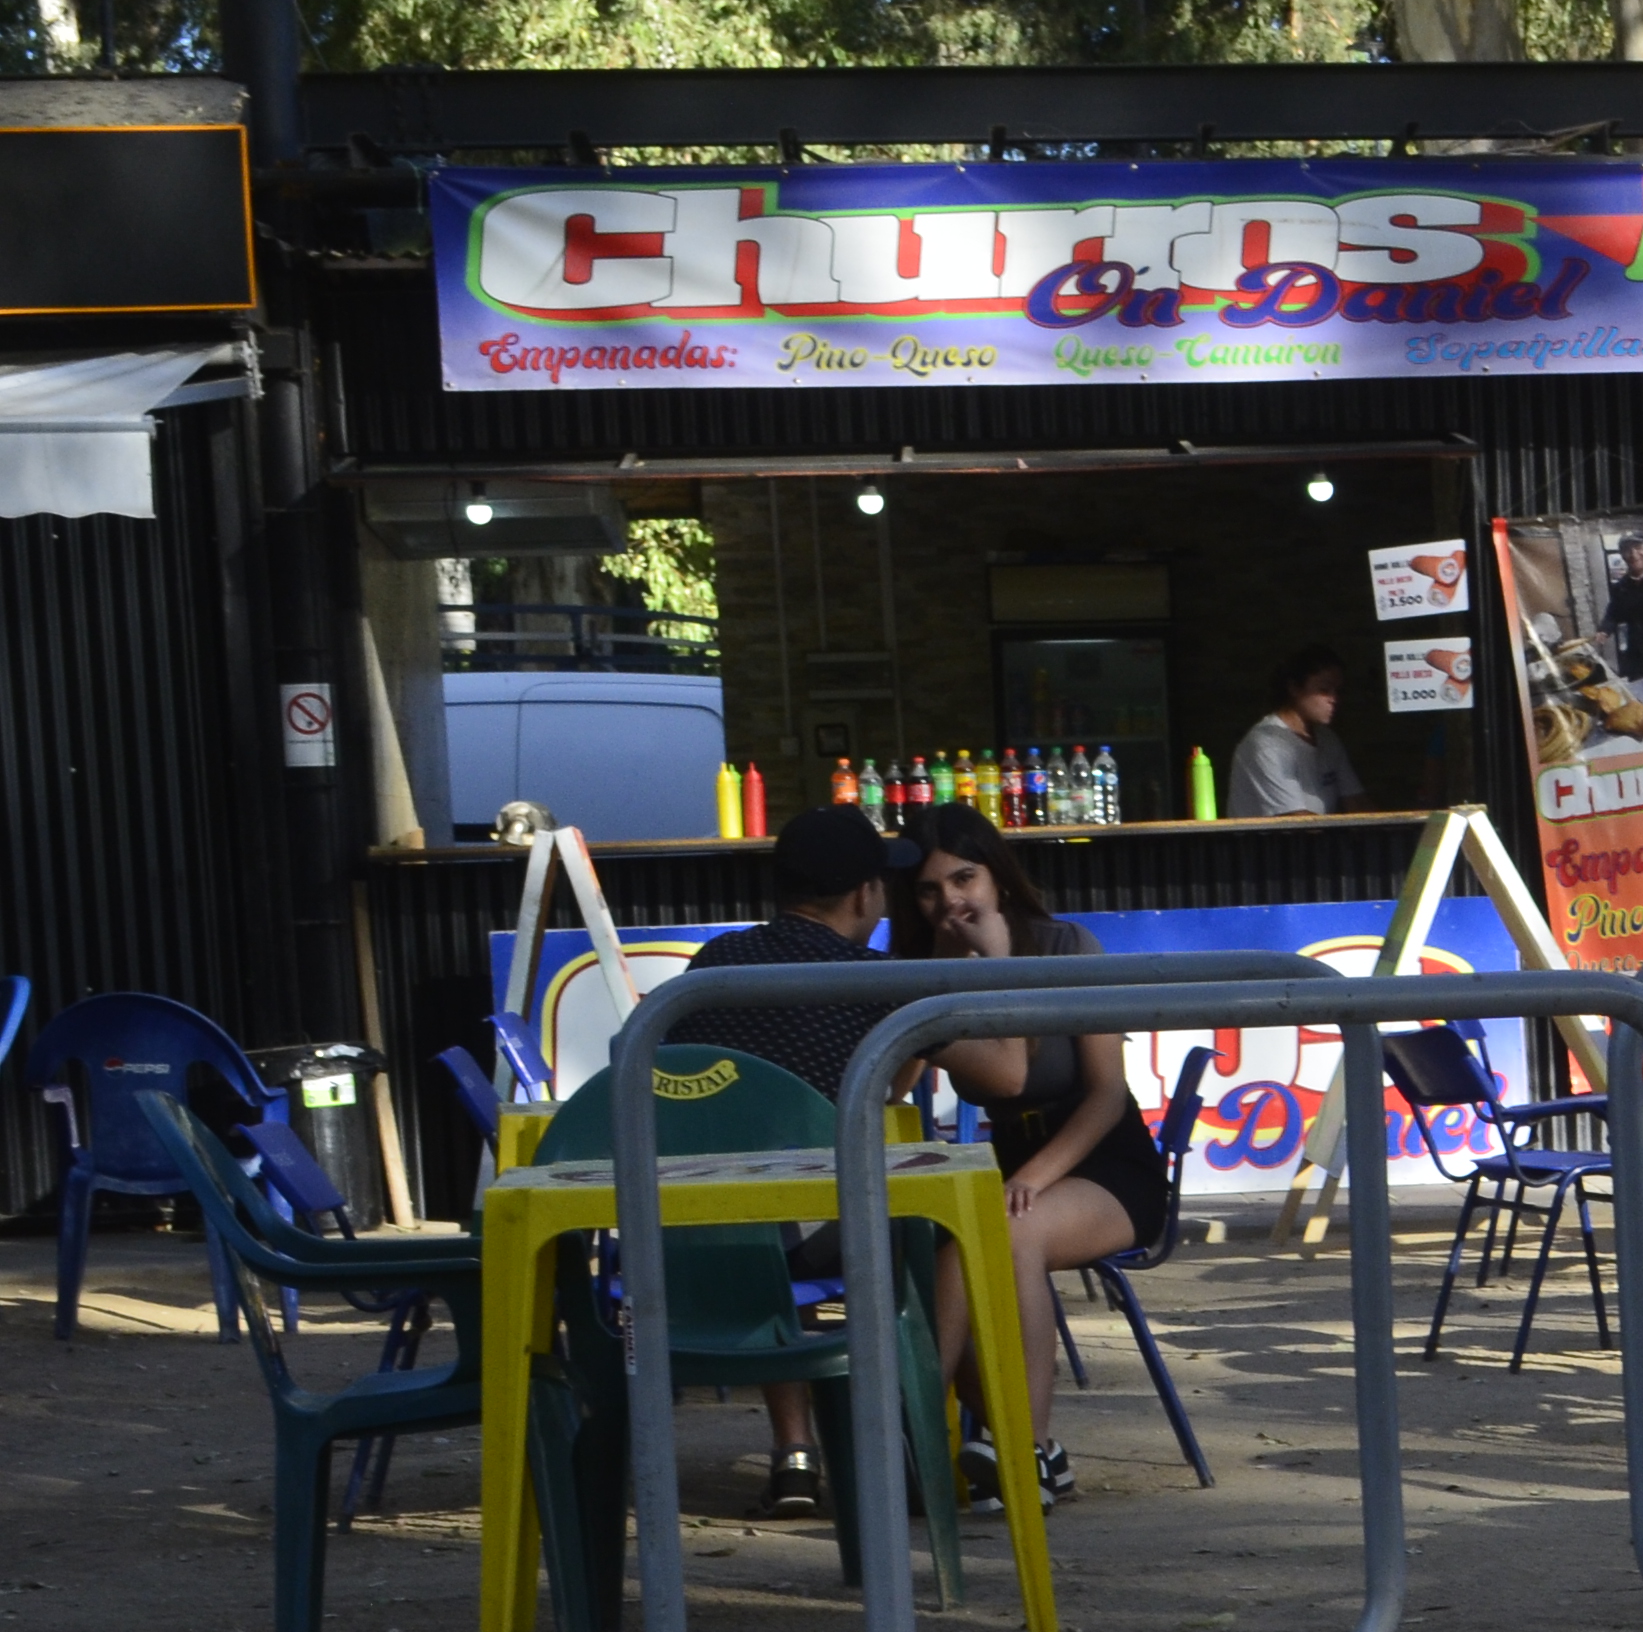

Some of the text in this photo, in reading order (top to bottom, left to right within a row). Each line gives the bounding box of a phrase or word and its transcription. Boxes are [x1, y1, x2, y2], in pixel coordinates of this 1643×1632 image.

[476, 184, 1500, 322] Churros
[1218, 257, 1590, 328] Daniel
[478, 329, 739, 384] Empanadas:
[655, 1069, 730, 1096] RISTAL
